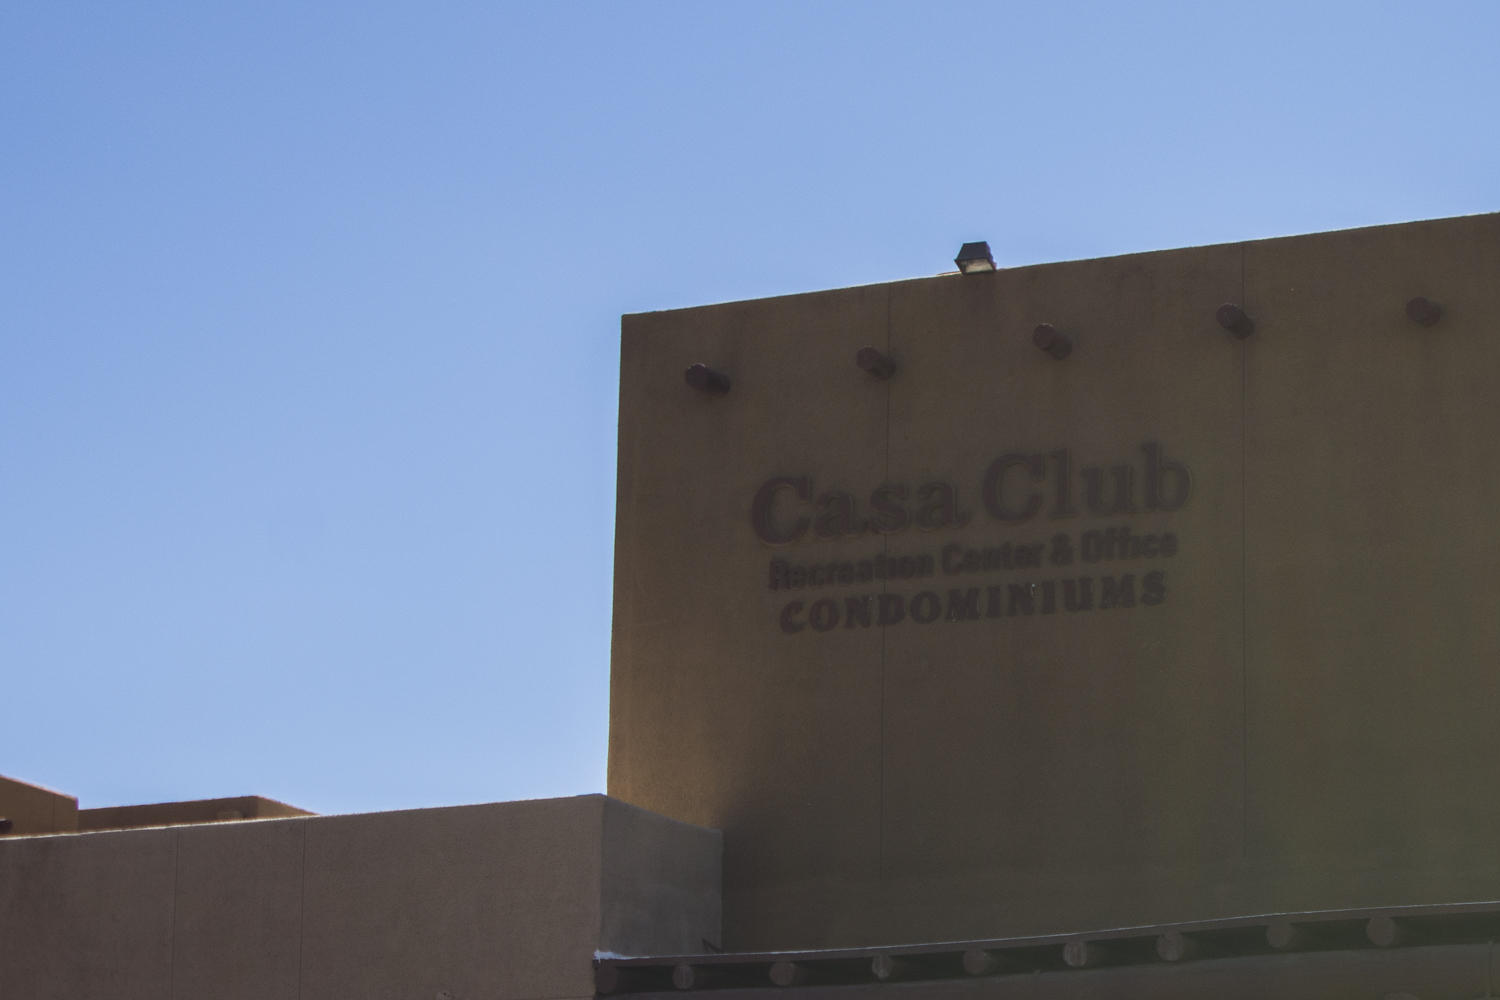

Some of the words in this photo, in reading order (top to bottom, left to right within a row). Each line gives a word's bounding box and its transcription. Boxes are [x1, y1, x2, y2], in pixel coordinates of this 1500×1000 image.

[751, 474, 973, 544] Casa
[981, 441, 1193, 523] Club
[769, 553, 936, 591] Recreation
[941, 542, 1046, 576] Center
[1050, 533, 1075, 567] &
[1079, 525, 1178, 563] Office
[779, 570, 1168, 635] CONDOMINIUMS
